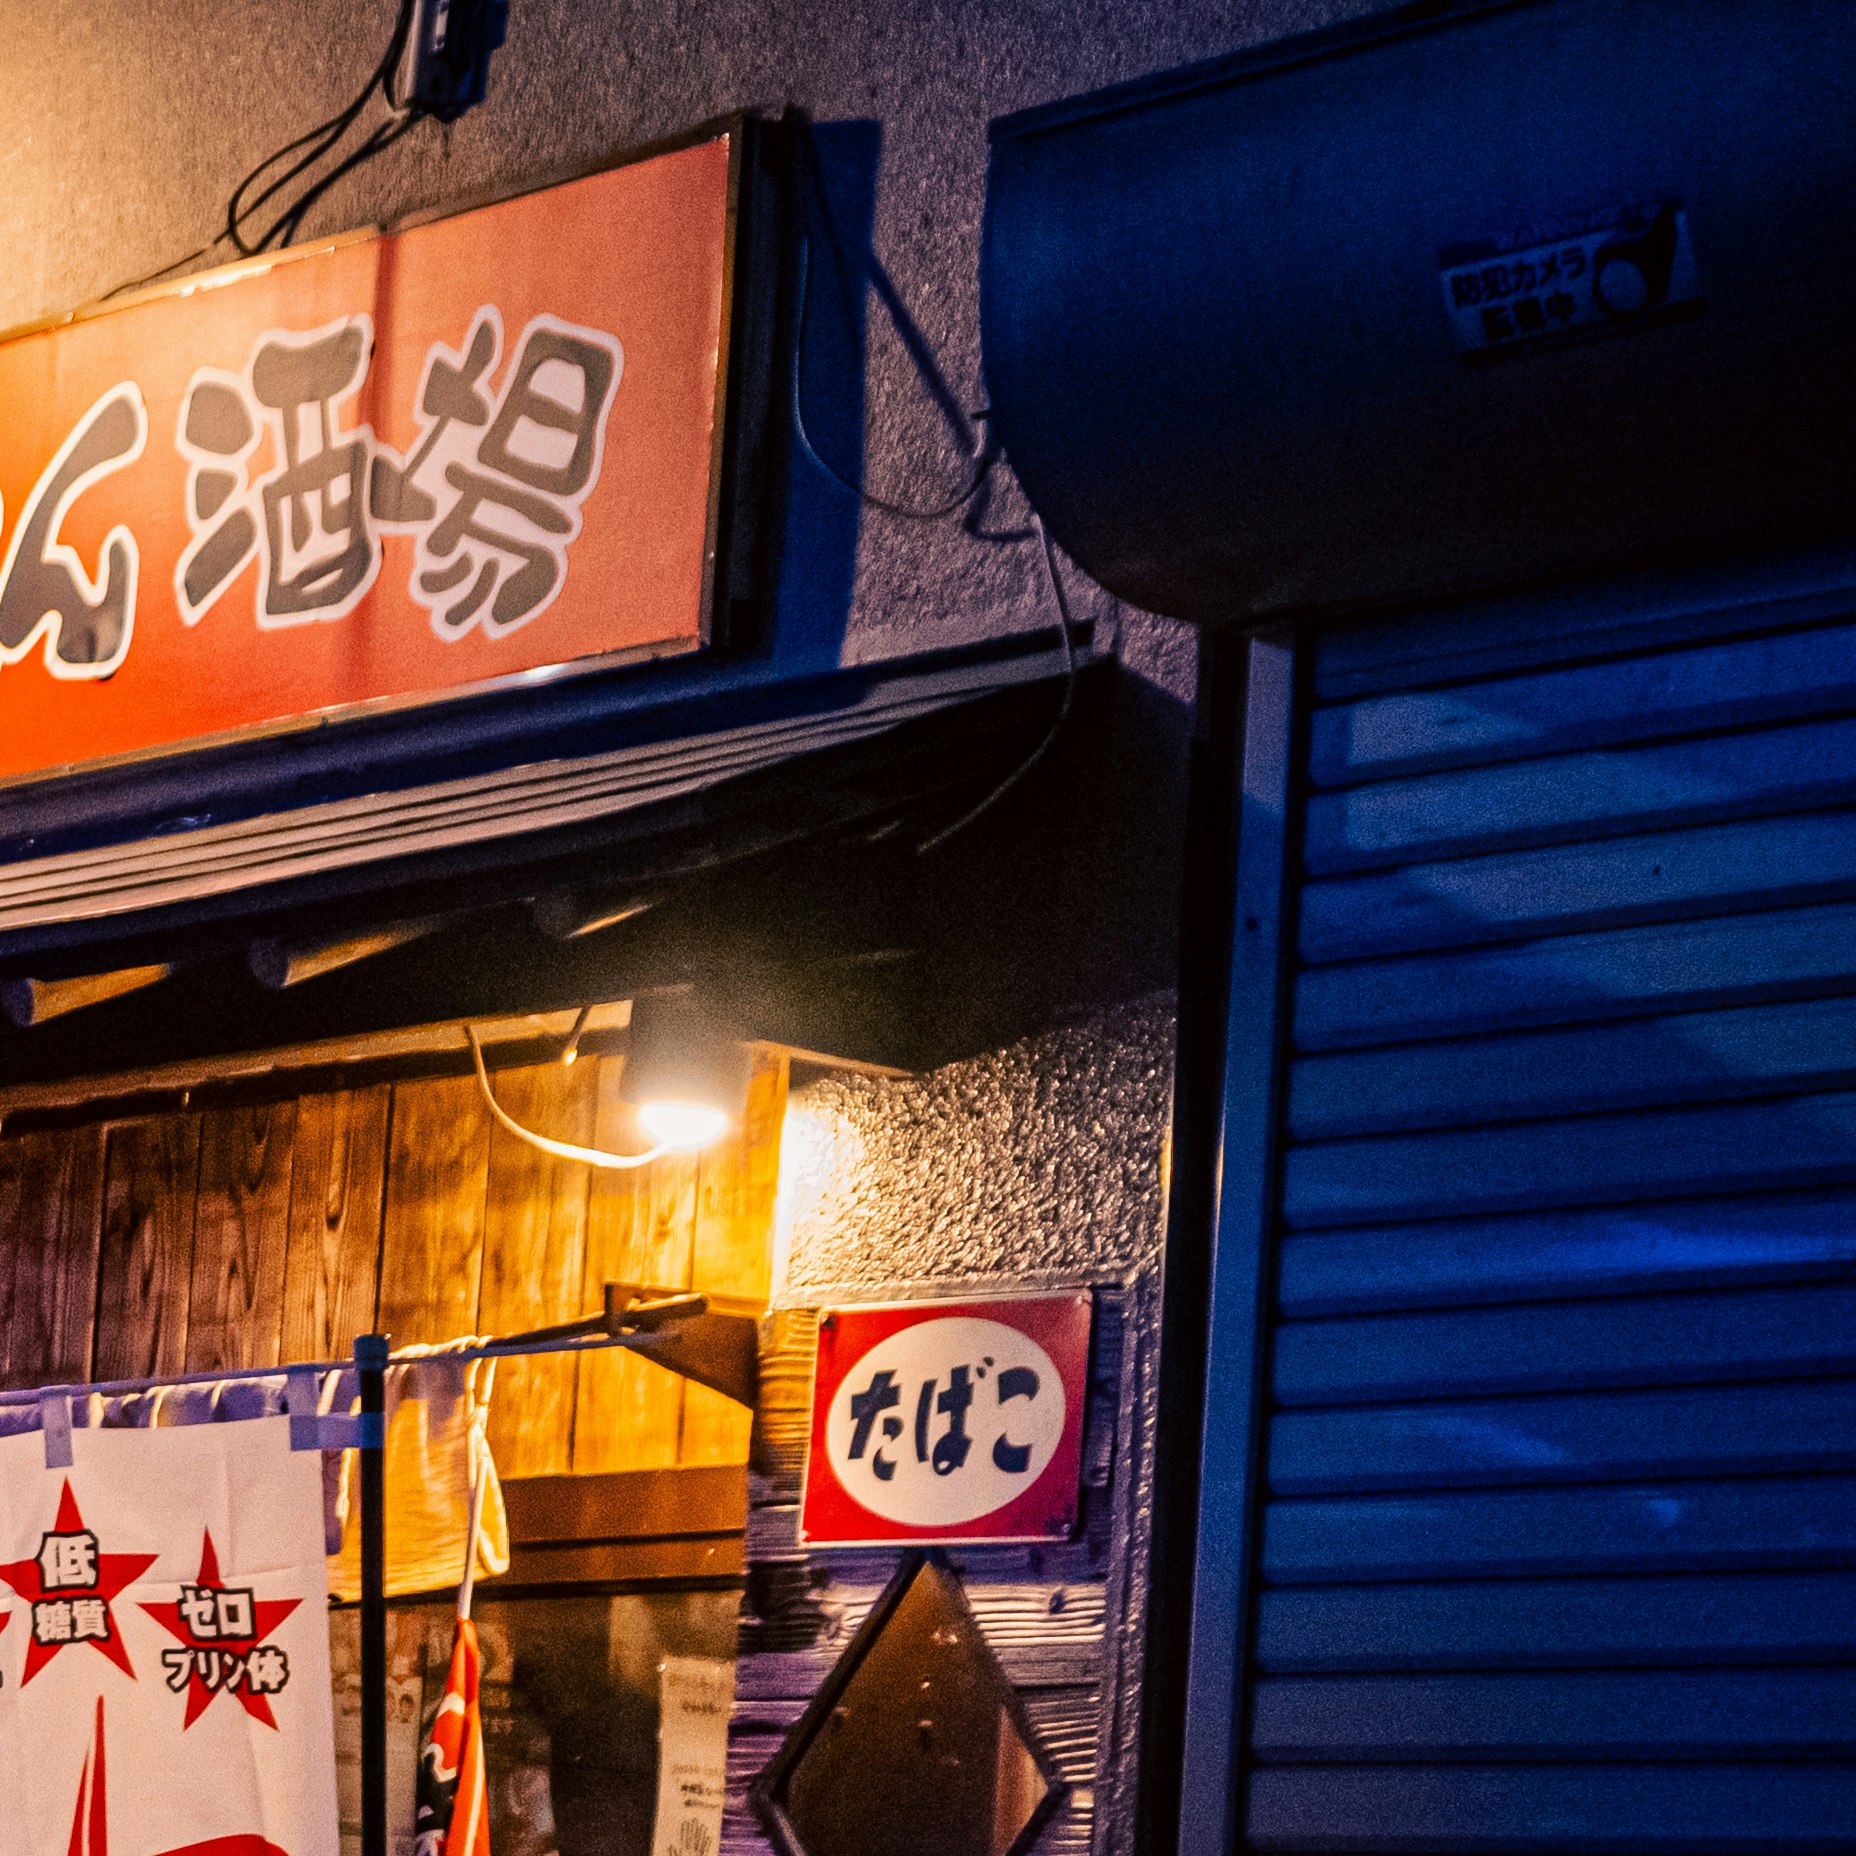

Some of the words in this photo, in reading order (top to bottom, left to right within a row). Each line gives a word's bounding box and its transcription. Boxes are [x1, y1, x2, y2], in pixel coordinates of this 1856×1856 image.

[848, 1354, 1042, 1481] たばこ
[35, 1530, 100, 1591] 低
[31, 1597, 114, 1647] 糖質
[179, 1584, 256, 1640] ゼロ
[161, 1645, 290, 1696] プリン体
